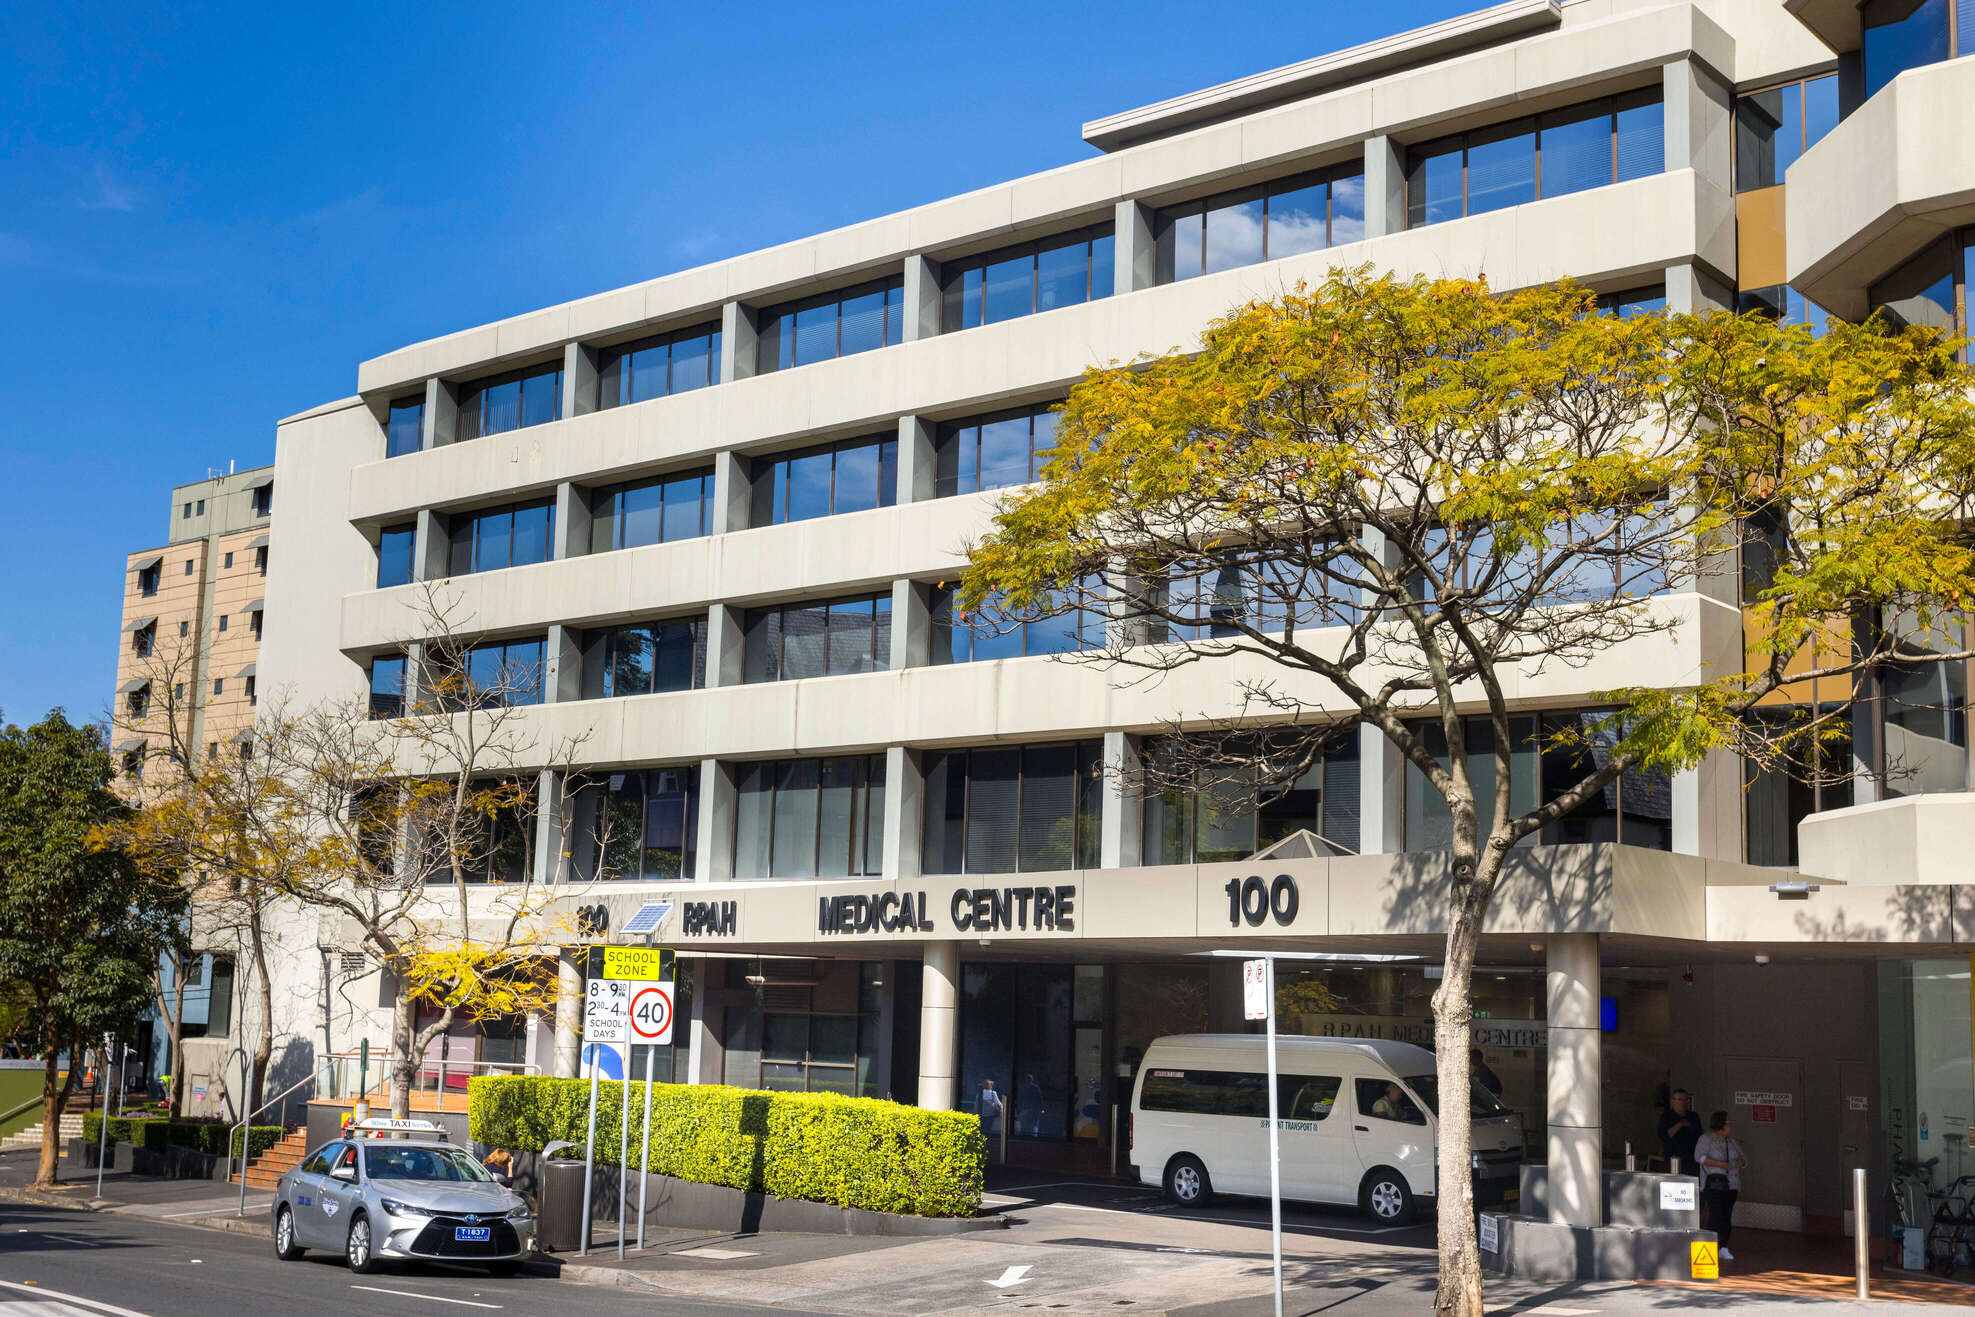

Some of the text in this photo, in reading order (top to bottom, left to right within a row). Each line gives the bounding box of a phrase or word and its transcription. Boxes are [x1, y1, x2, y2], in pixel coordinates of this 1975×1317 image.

[683, 901, 737, 936] RPAH
[819, 891, 934, 935] MEDICAL
[951, 885, 1076, 932] CENTRE
[1225, 875, 1299, 928] 100
[608, 952, 656, 963] SCHOOL
[616, 965, 647, 976] ZONE
[636, 1002, 664, 1024] 40
[590, 1020, 622, 1028] SCHOOL
[593, 1030, 616, 1038] DAYS
[1475, 1028, 1548, 1045] CENTRE
[389, 1119, 411, 1128] TAXI
[1285, 1121, 1313, 1131] TRANSPORT
